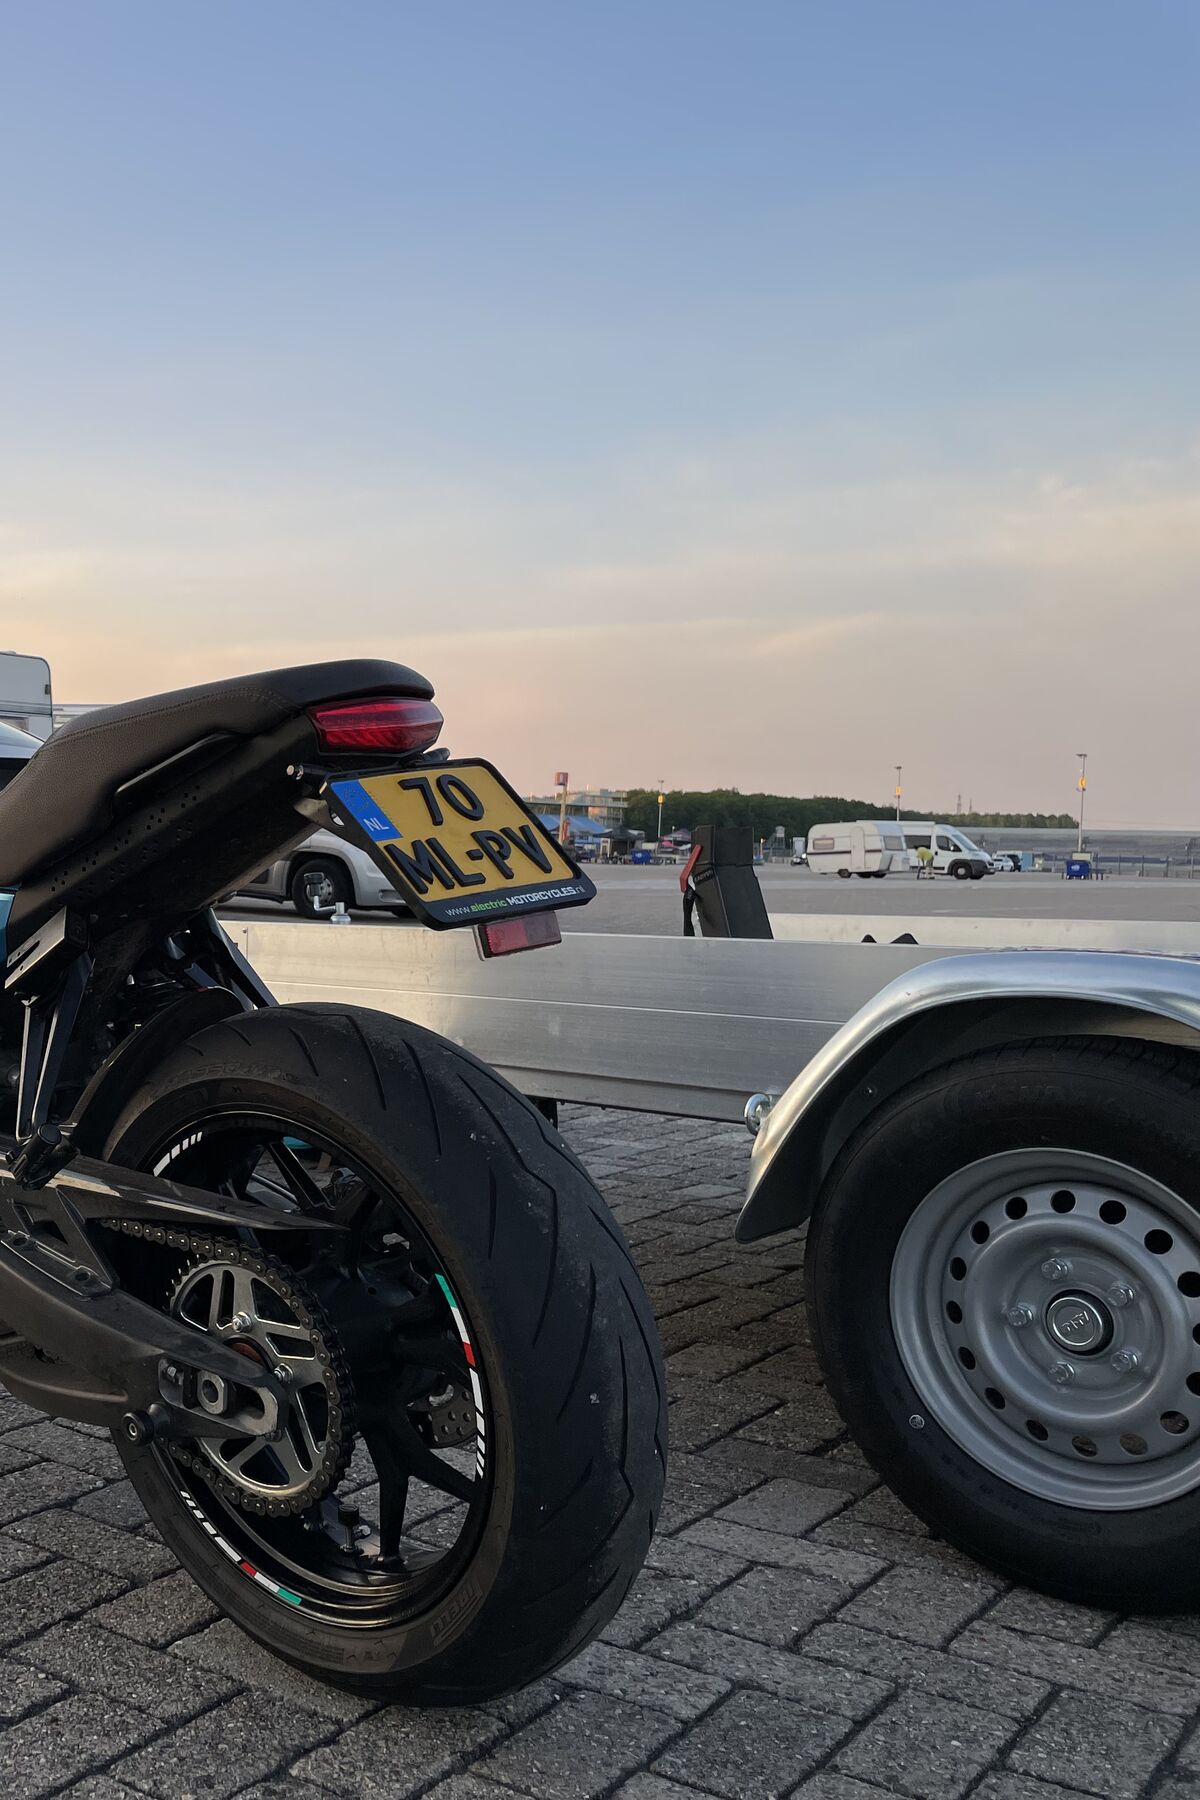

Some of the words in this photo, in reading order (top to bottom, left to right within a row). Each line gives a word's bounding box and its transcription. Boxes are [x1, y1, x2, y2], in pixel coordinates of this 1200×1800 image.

[363, 817, 390, 832] NL
[398, 774, 485, 826] 70
[383, 824, 553, 895] ML-PV
